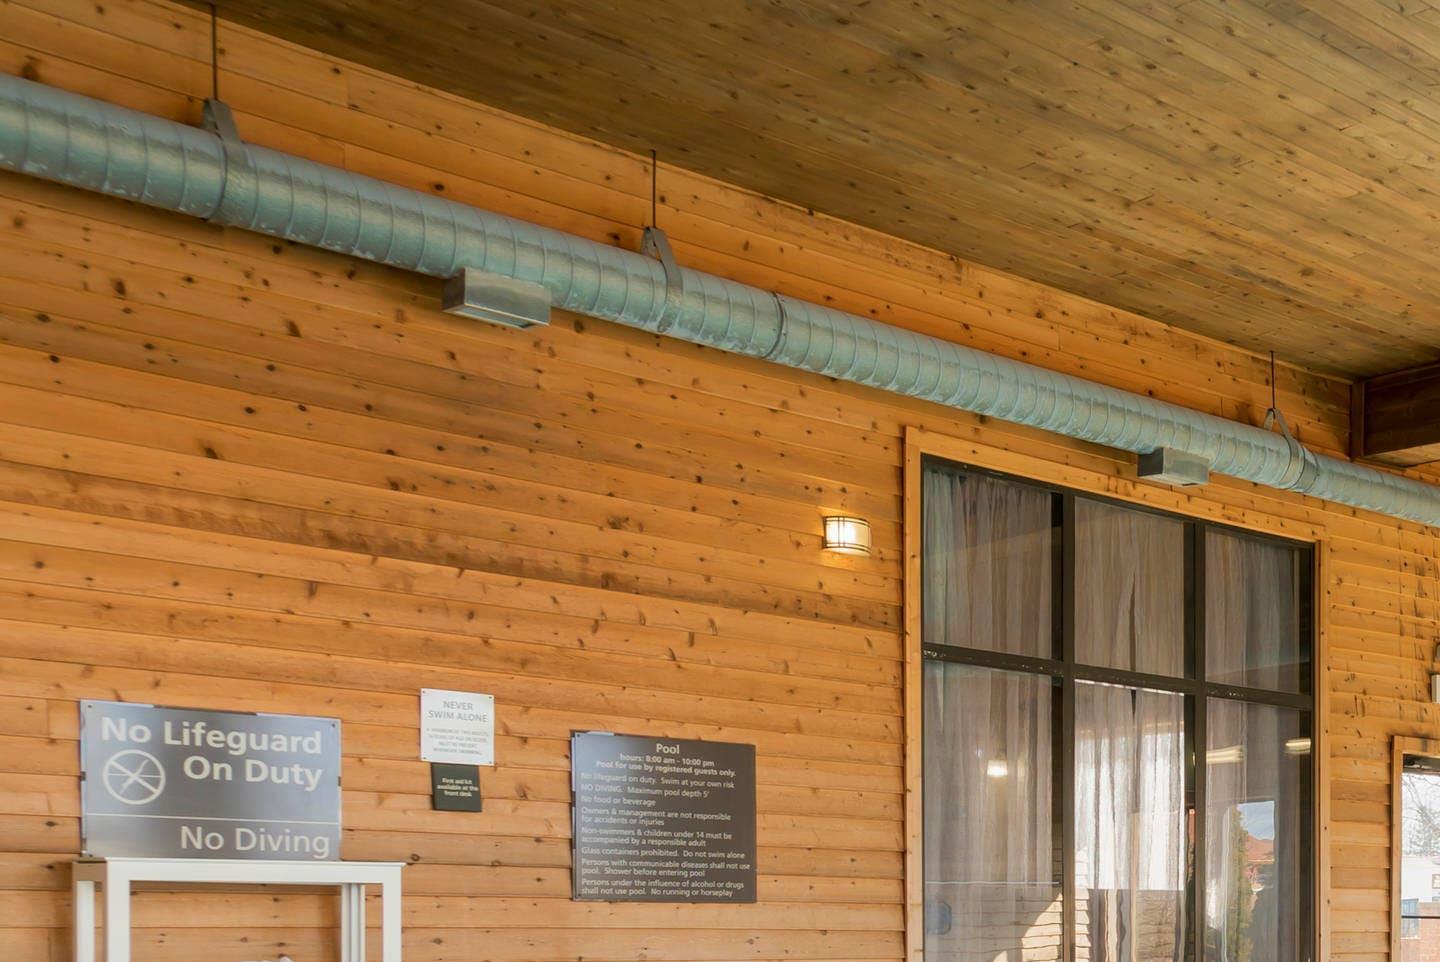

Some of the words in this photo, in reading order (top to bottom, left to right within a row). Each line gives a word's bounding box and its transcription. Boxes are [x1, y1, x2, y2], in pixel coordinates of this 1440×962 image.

[443, 700, 473, 711] NEVER
[428, 711, 454, 720] SWIM
[457, 714, 488, 723] ALONE
[102, 717, 152, 743] No
[164, 721, 322, 756] Lifeguard
[656, 743, 680, 755] Pool
[620, 753, 644, 762] hours:
[646, 755, 662, 763] 8:00
[682, 758, 702, 766] 10:00
[703, 760, 714, 768] pm
[183, 755, 232, 780] On
[246, 759, 323, 792] Duty
[596, 760, 614, 768] Pool
[616, 760, 627, 769] for
[629, 762, 642, 770] use
[644, 762, 654, 772] by
[655, 764, 692, 774] registered
[694, 766, 718, 776] guests
[719, 767, 736, 778] only.
[640, 776, 657, 785] duty.
[628, 786, 662, 795] Maximum
[682, 790, 702, 798] depth
[622, 798, 656, 807] beverage
[594, 816, 628, 824] accidents
[638, 818, 664, 826] injuries
[618, 809, 666, 818] management
[694, 813, 732, 821] responsible
[644, 829, 672, 837] children
[724, 832, 732, 840] be
[181, 826, 224, 850] No
[236, 828, 329, 858] Diving
[582, 836, 630, 844] accompanied
[631, 838, 640, 846] by
[648, 839, 687, 847] responsible
[582, 846, 600, 854] Glass
[602, 848, 640, 856] containers
[640, 848, 679, 858] prohibited.
[695, 850, 706, 858] not
[582, 858, 610, 866] Persons
[628, 860, 680, 868] communicable
[726, 862, 738, 870] not
[582, 867, 599, 876] pool.
[658, 869, 688, 878] entering
[690, 870, 705, 878] pool
[582, 878, 610, 886] Persons
[691, 880, 716, 888] alcohol
[726, 882, 744, 890] drugs
[582, 886, 598, 894] shall
[628, 888, 646, 896] pool.
[662, 888, 690, 897] running
[692, 888, 700, 896] or
[700, 888, 733, 898] horseplay
